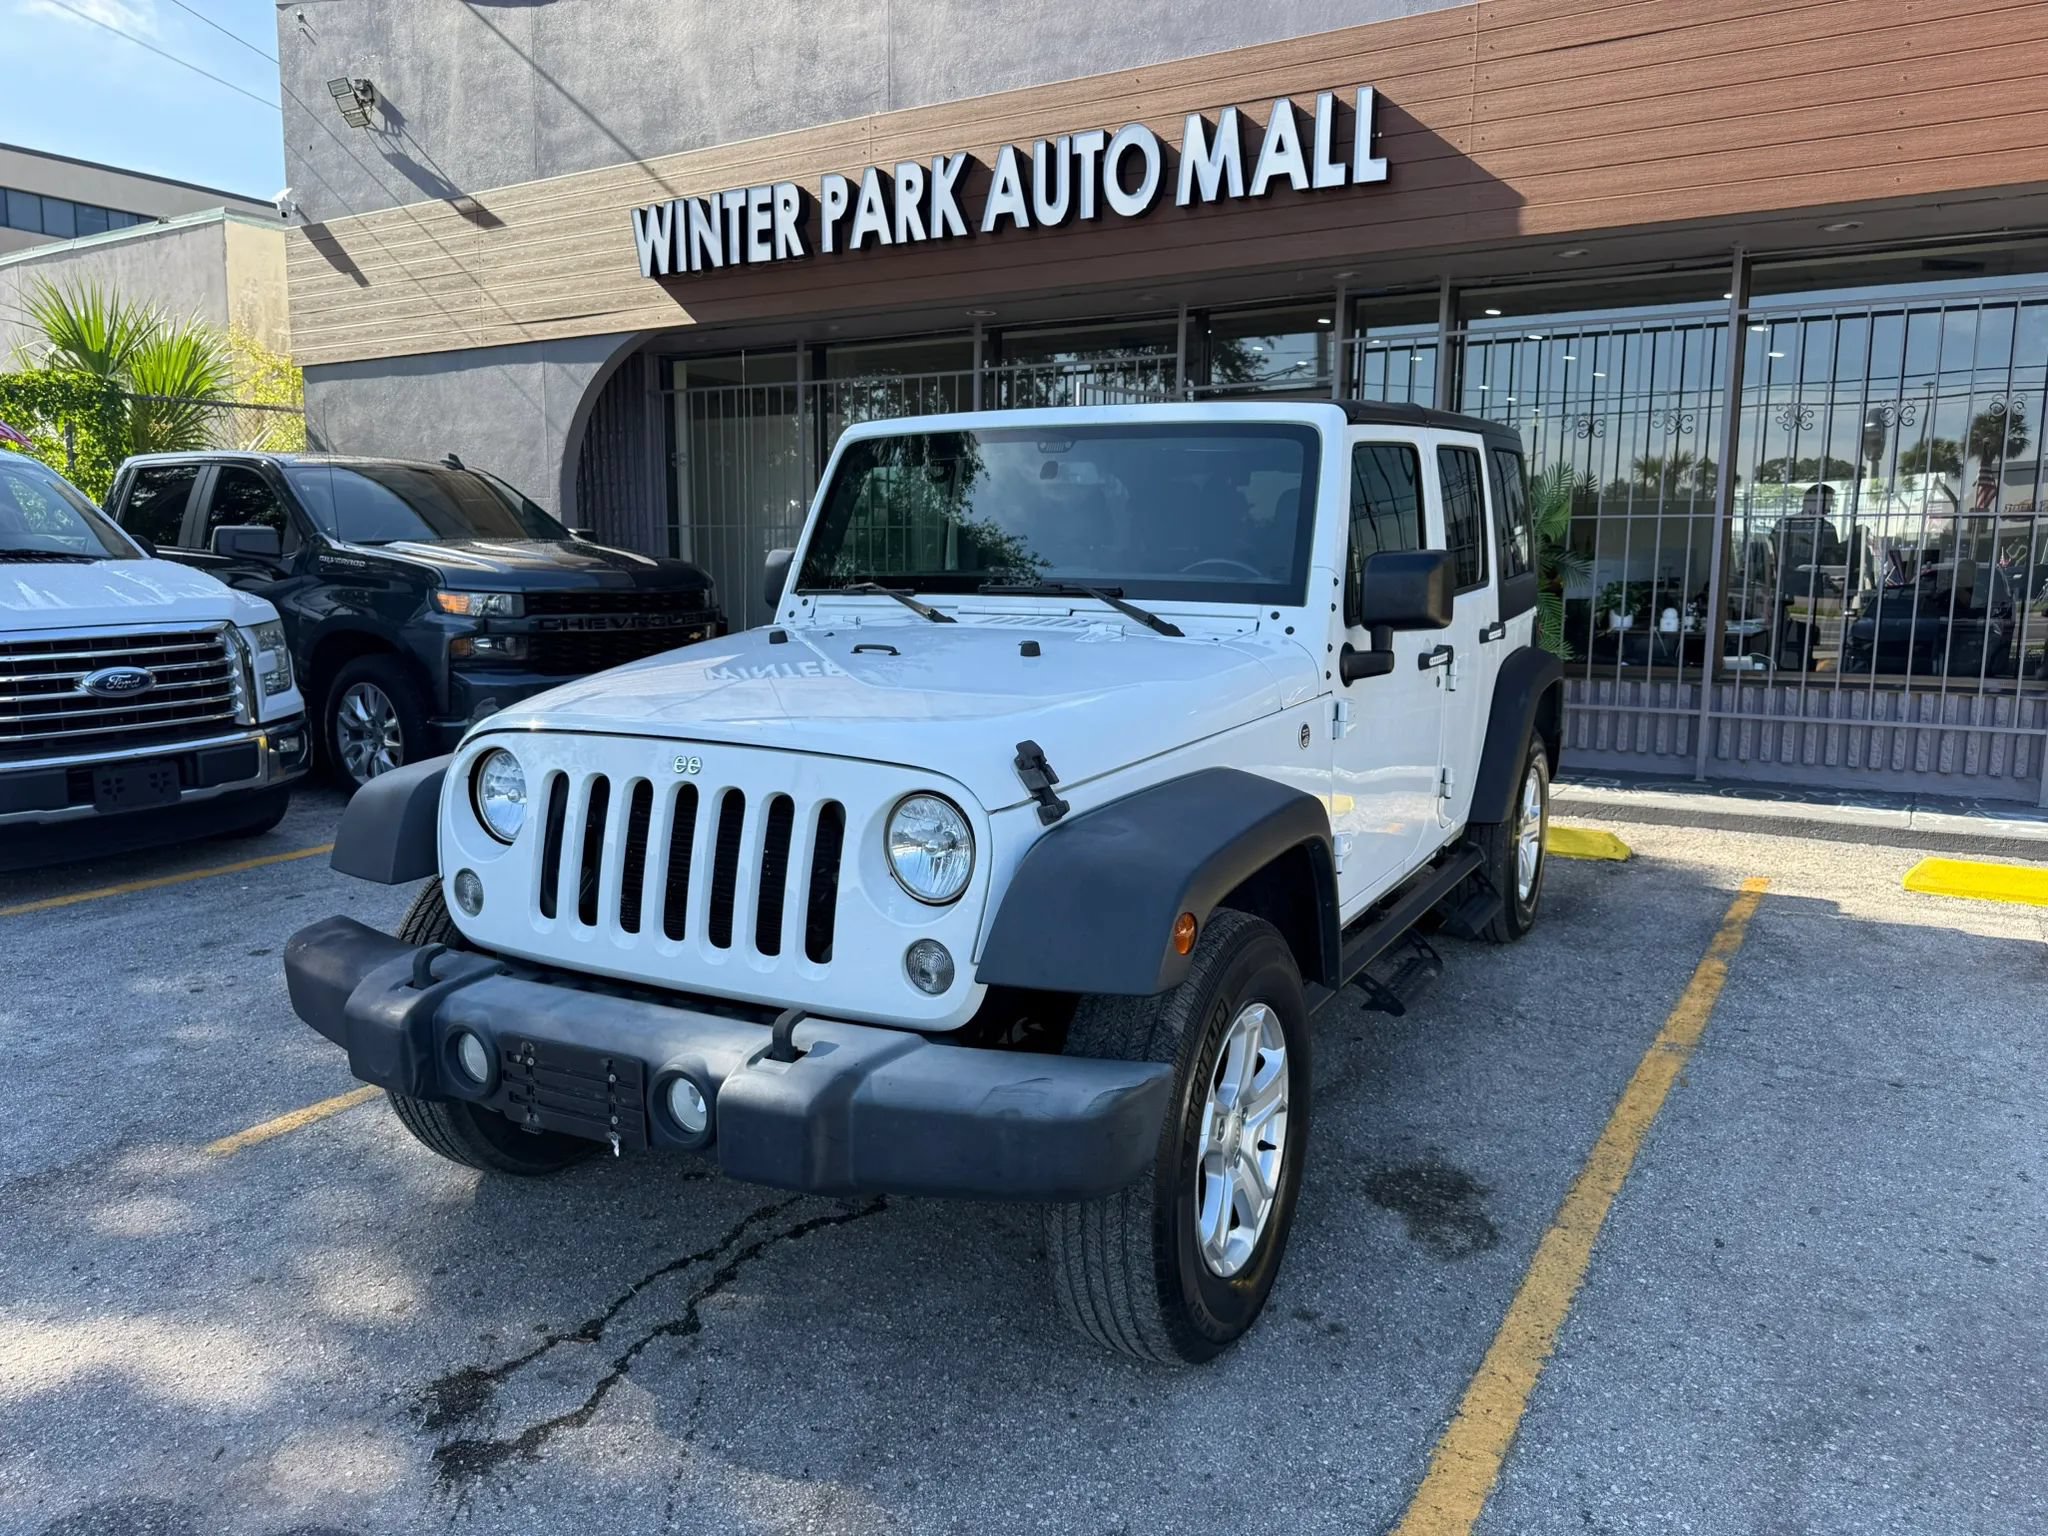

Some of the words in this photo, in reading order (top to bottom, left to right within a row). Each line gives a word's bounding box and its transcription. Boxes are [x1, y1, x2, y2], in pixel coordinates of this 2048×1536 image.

[632, 182, 804, 278] WINTER
[820, 152, 969, 253] PARK
[981, 122, 1161, 233] AUTO
[1175, 86, 1388, 206] MALL
[539, 612, 717, 631] CHEVROLET
[106, 674, 140, 689] Ford
